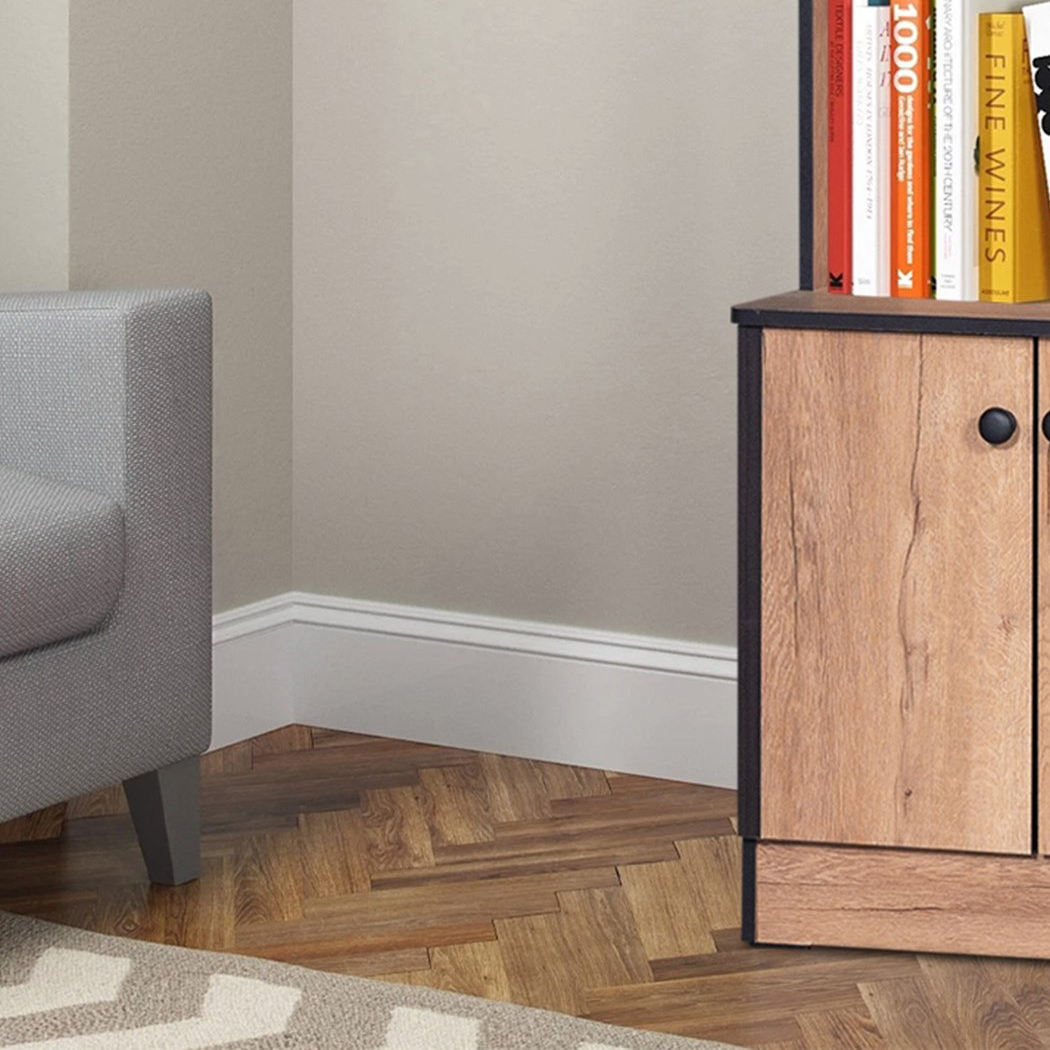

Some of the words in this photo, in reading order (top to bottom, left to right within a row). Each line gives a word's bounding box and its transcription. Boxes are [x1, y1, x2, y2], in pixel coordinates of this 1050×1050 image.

[835, 4, 844, 40] TEXTILE
[893, 3, 919, 94] 1000
[835, 43, 844, 98] DESIGNERS
[984, 54, 1006, 131] FINE
[943, 177, 954, 232] CENTURY
[984, 148, 1006, 263] WINES
